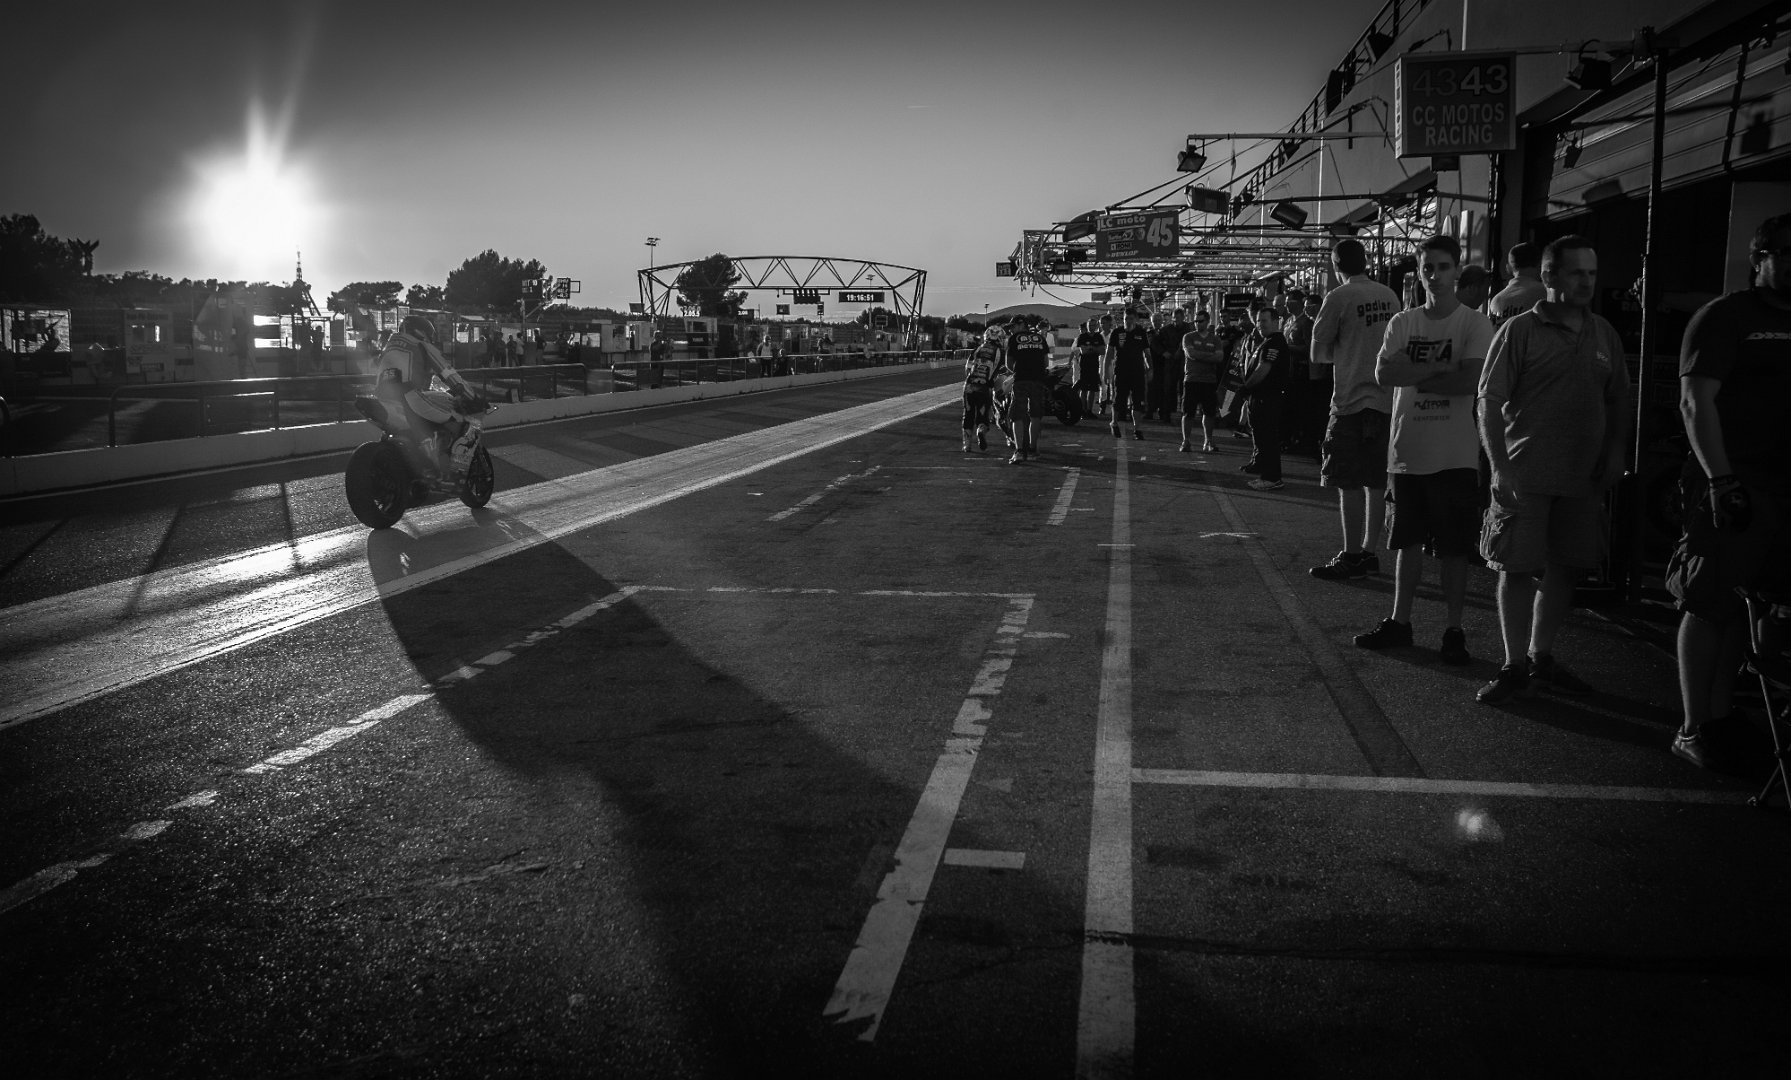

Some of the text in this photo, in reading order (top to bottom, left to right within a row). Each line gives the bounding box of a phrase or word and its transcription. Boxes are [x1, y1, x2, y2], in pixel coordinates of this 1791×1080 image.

[1412, 102, 1505, 126] CC MOTOS
[1425, 123, 1493, 147] RACING
[1117, 215, 1147, 225] moto
[1147, 217, 1174, 248] 45
[1357, 300, 1391, 317] godier
